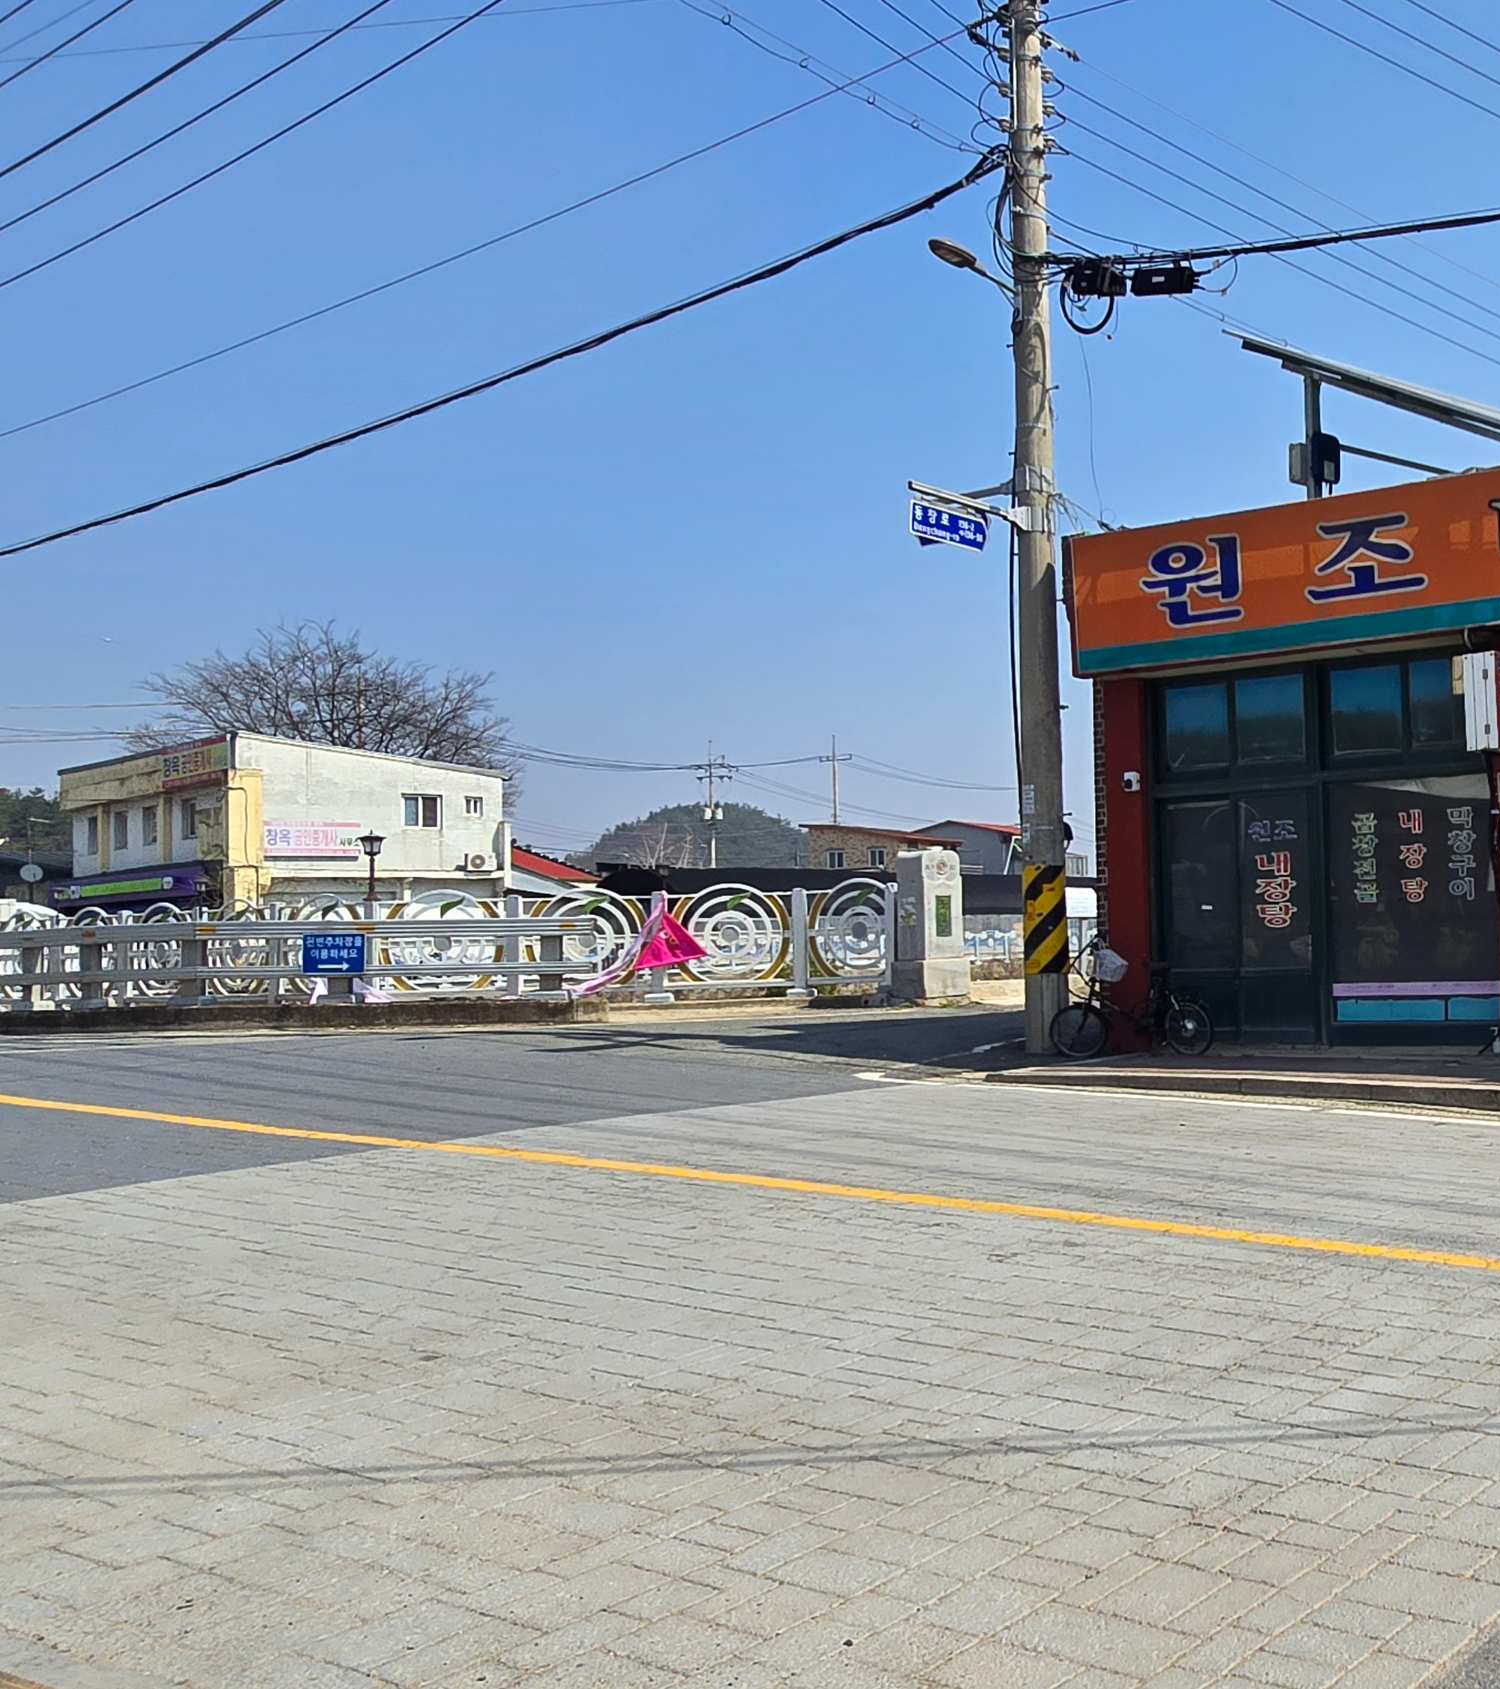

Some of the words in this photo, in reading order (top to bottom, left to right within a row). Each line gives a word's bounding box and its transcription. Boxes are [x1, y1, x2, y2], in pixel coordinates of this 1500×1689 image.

[265, 828, 291, 847] 창옥
[294, 829, 337, 847] 공인중개사
[1247, 819, 1298, 842] 원조
[1398, 808, 1428, 903] 내장탕
[1446, 806, 1478, 901] 막창구이
[1255, 851, 1297, 929] 내장탕
[310, 948, 359, 960] 이용하세요
